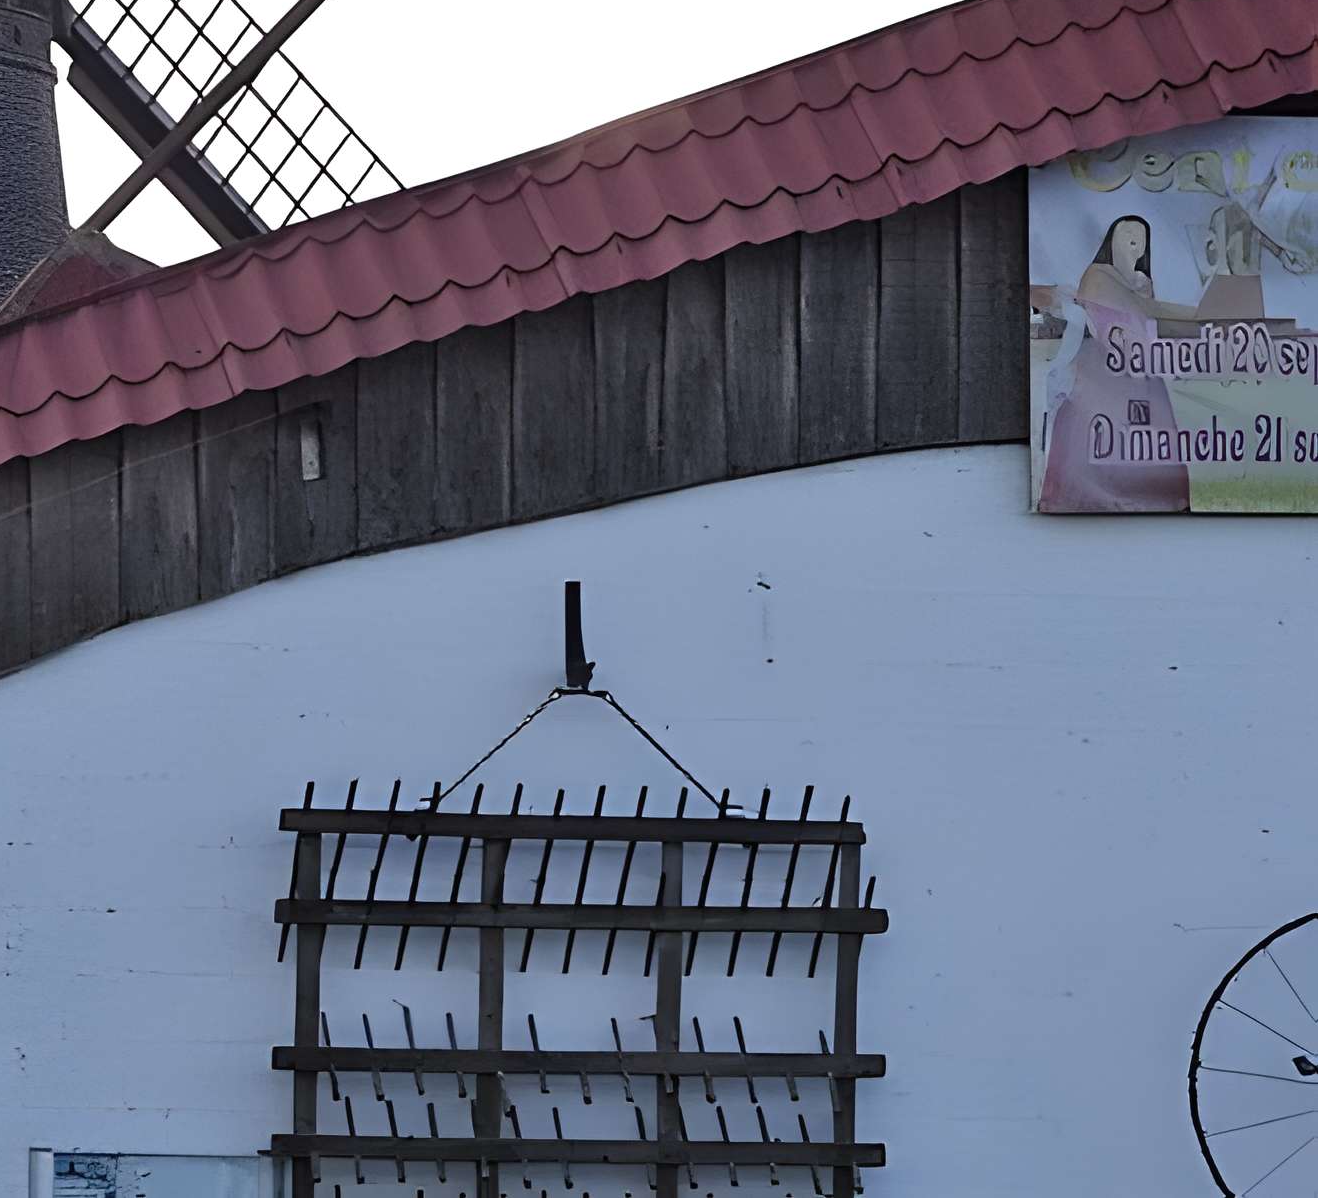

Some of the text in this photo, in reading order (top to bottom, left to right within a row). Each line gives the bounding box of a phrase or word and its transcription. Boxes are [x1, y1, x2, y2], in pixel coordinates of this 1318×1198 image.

[1106, 324, 1221, 373] Samedi
[1233, 325, 1269, 373] 20
[1090, 413, 1244, 462] Dimanche
[1255, 414, 1282, 462] 21
